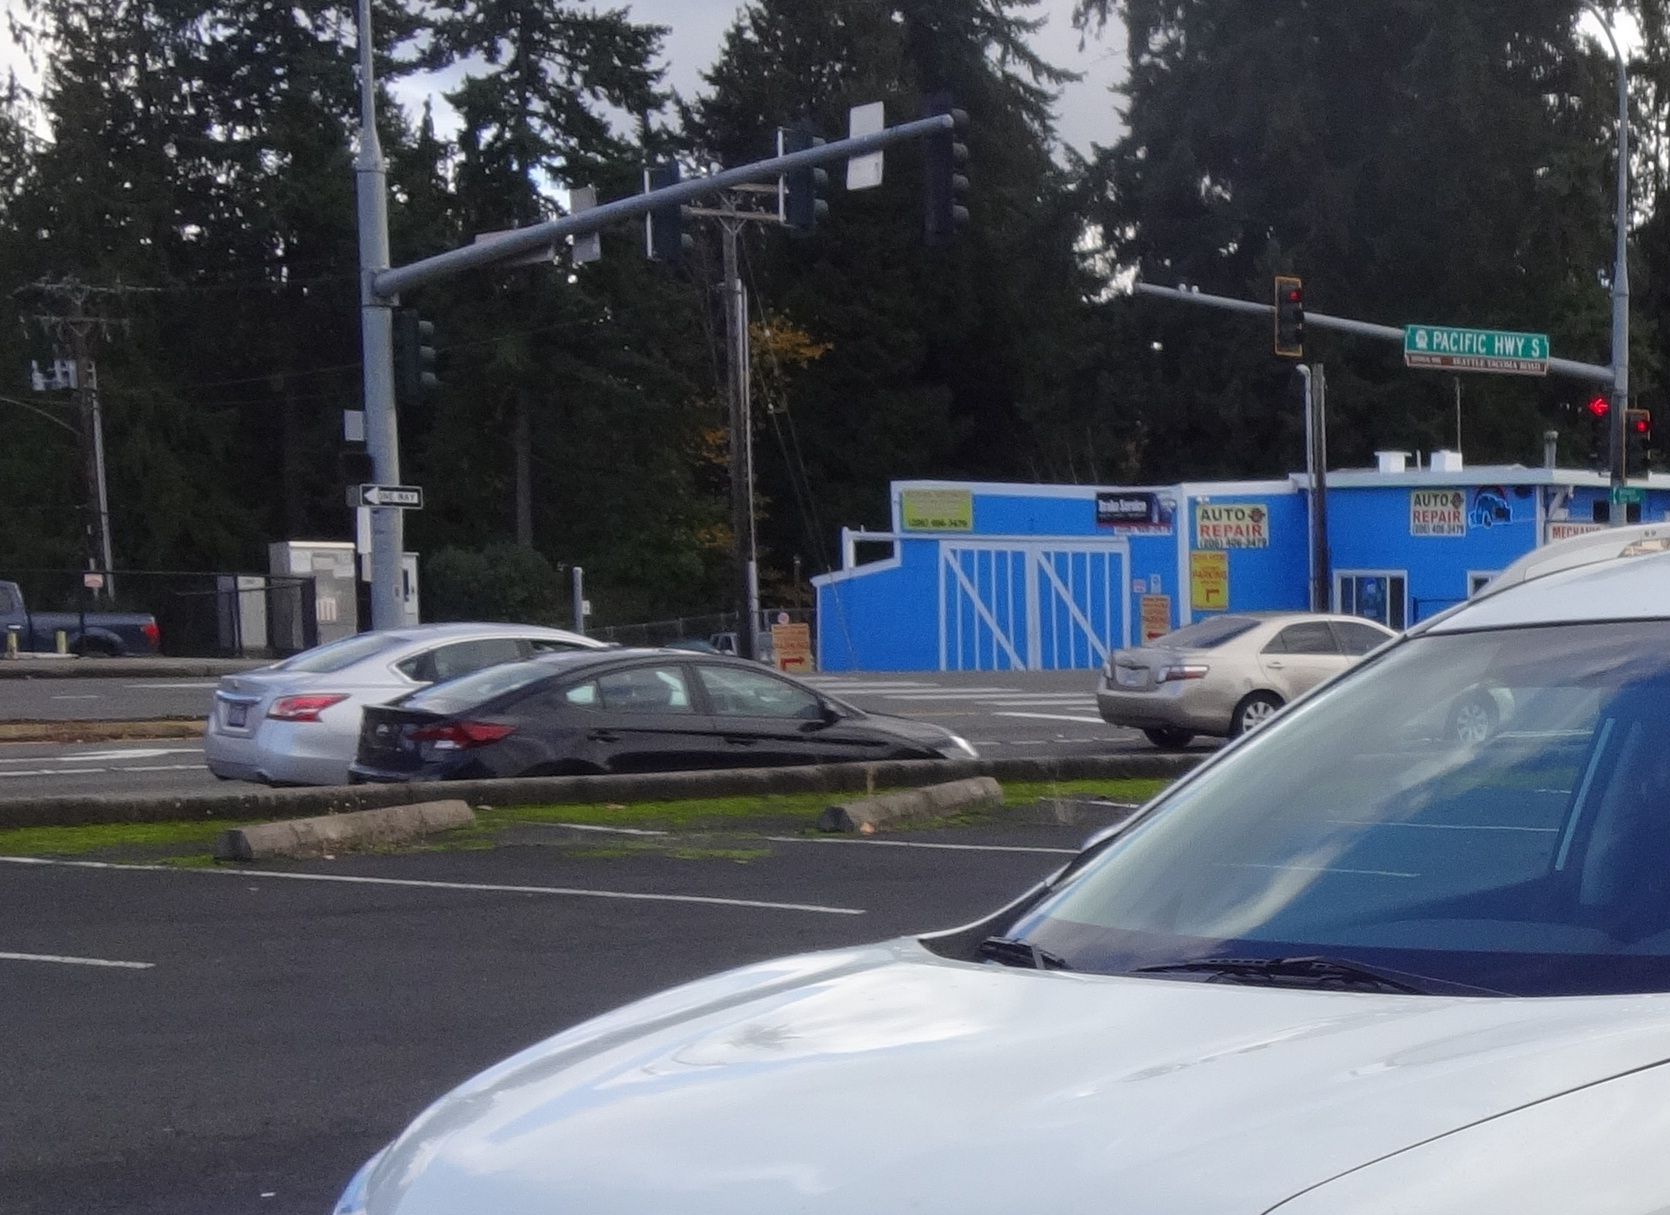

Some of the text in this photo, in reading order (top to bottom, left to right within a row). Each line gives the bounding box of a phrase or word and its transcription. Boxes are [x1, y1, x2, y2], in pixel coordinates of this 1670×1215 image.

[1432, 331, 1541, 358] PACIFIC HWY S
[378, 491, 416, 502] ONE WAY
[1414, 493, 1449, 507] AUTO
[1201, 508, 1246, 521] AUTO
[1413, 510, 1461, 523] REPAIR
[1200, 524, 1263, 537] REPAIR
